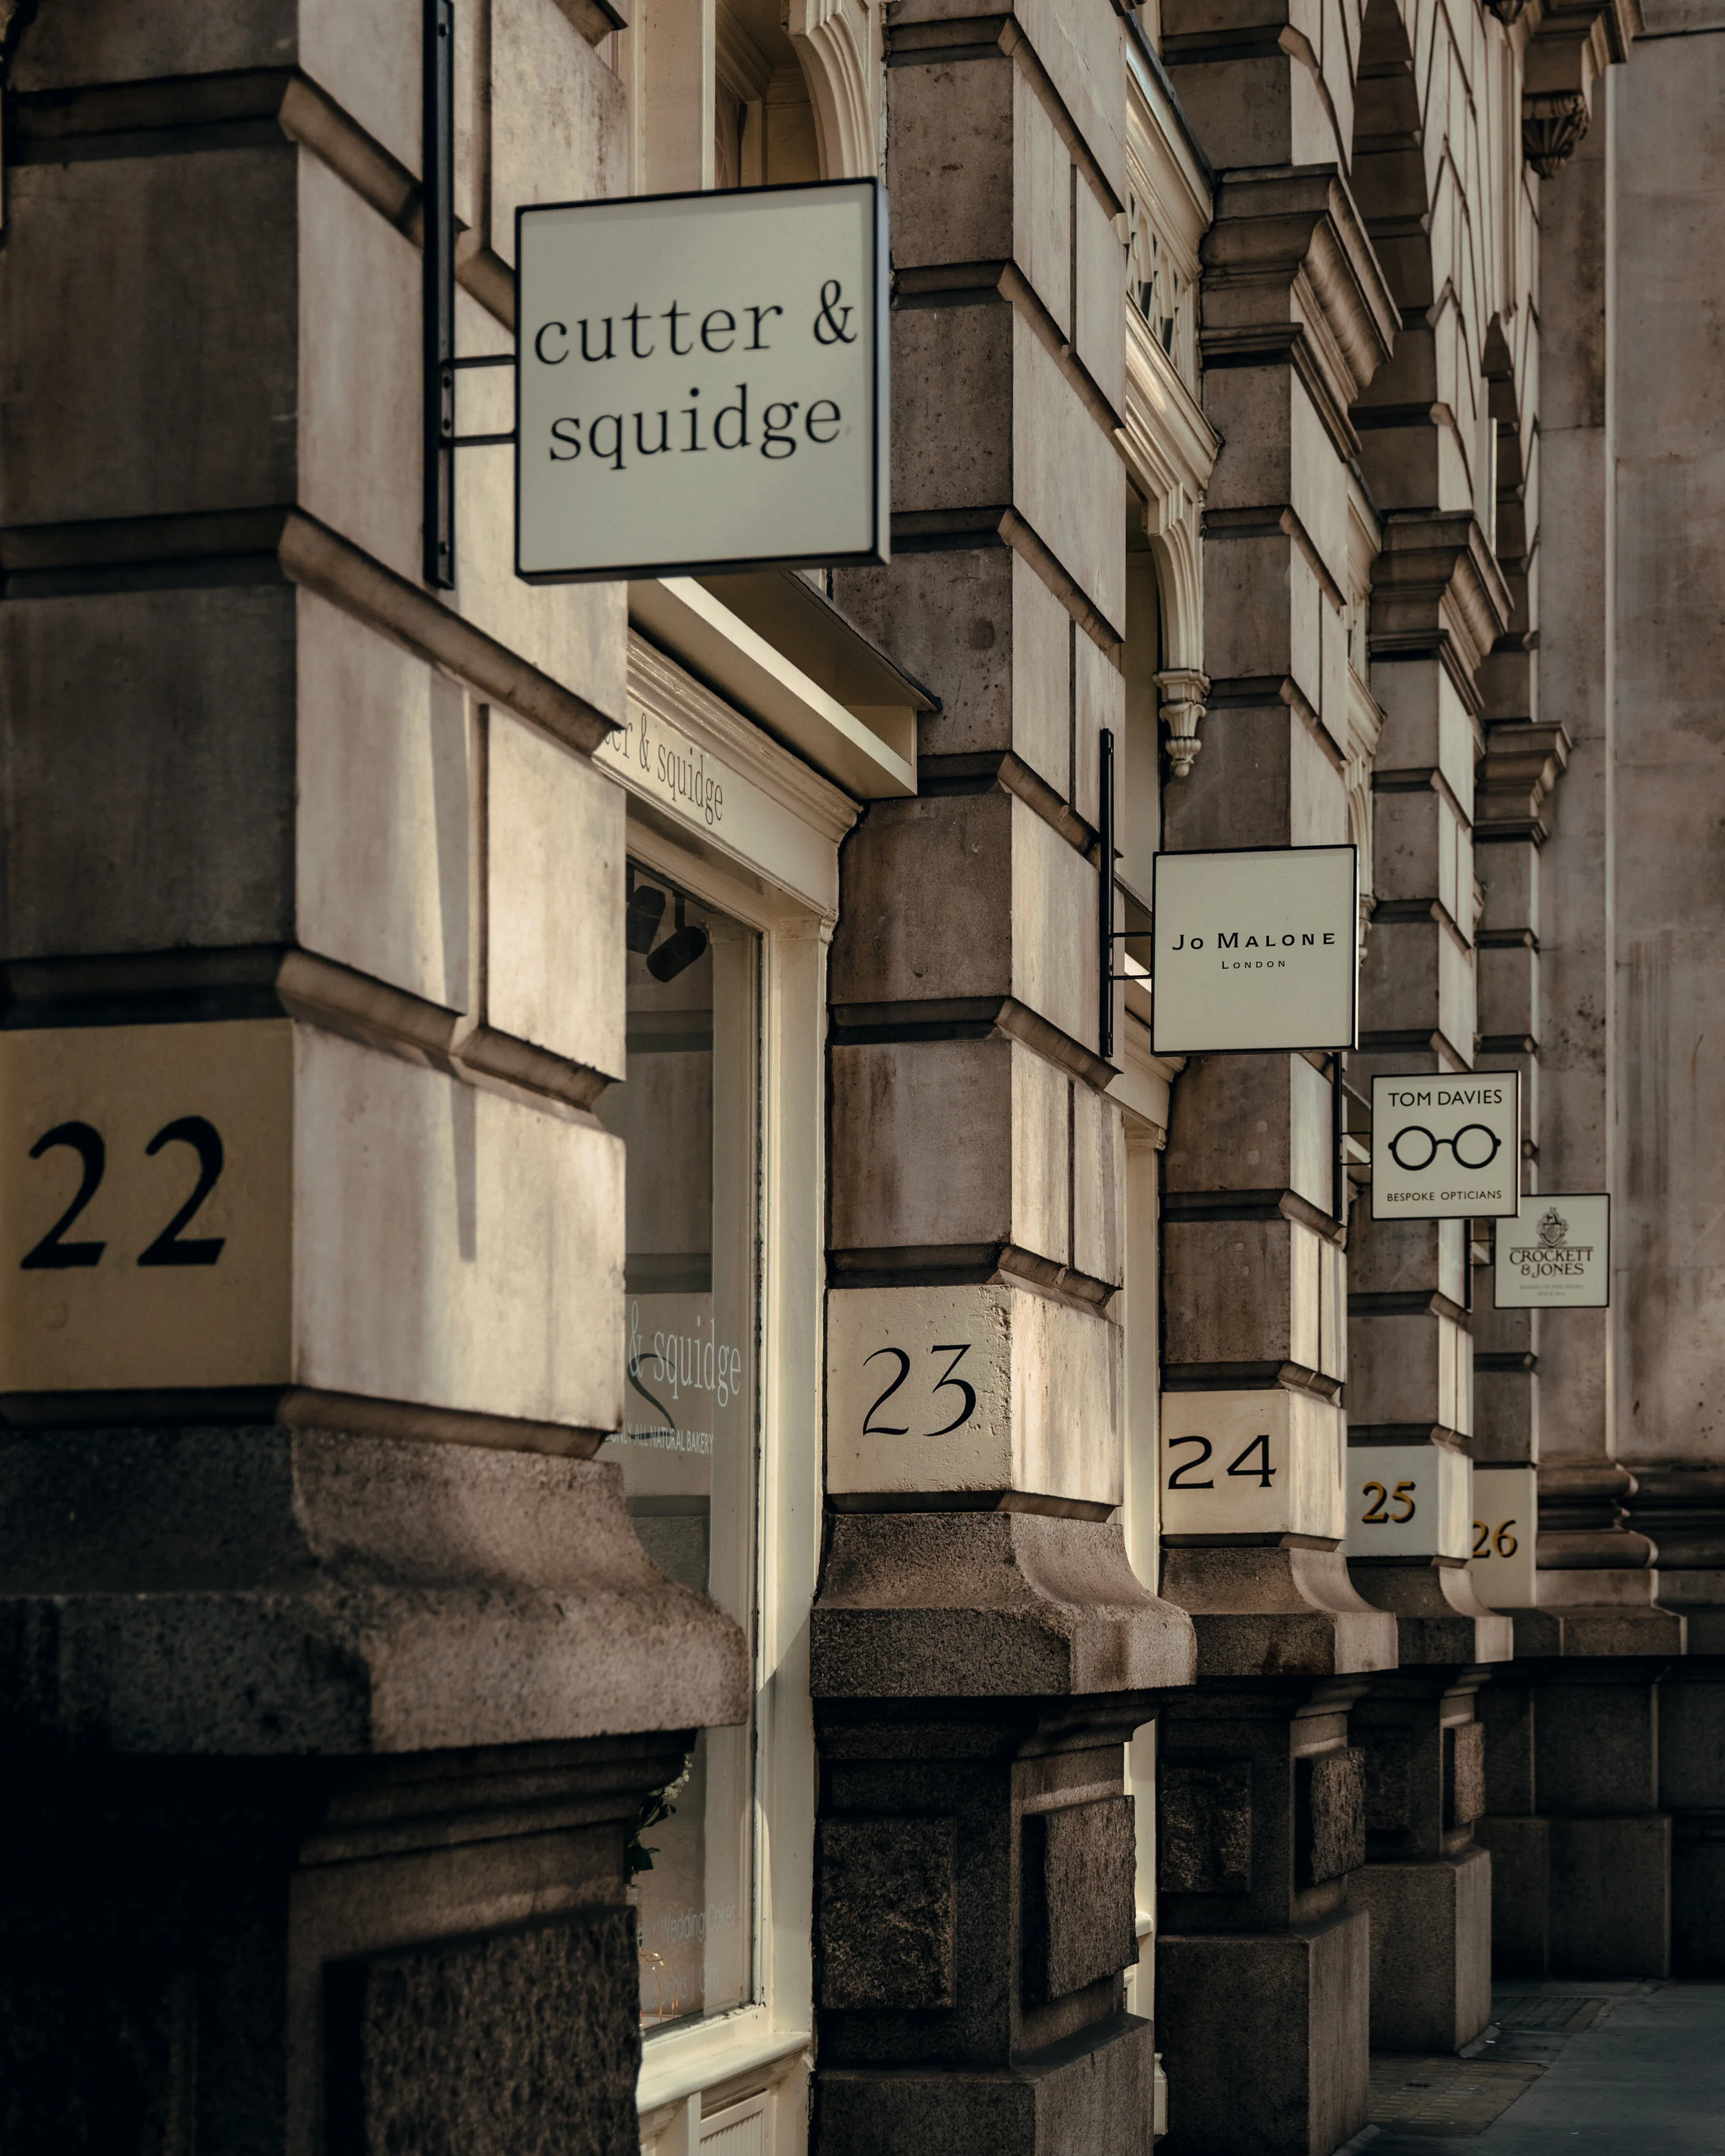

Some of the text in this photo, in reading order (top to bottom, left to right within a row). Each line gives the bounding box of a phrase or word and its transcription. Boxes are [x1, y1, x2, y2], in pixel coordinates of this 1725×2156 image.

[534, 279, 858, 365] cutter &
[549, 383, 842, 471] squidge
[639, 713, 651, 772] &
[658, 744, 723, 825] squidge
[1217, 932, 1336, 949] MALONE
[1221, 960, 1285, 969] LONDON
[1388, 1089, 1502, 1107] TOM DAVIES
[20, 1115, 227, 1269] 22
[1387, 1190, 1502, 1202] BESPOKE OPTICIANS
[1509, 1249, 1595, 1265] CROCKETT
[629, 1300, 742, 1407] & squidge
[862, 1344, 976, 1436] 23
[633, 1423, 649, 1446] ALL
[650, 1425, 685, 1452] NATURAL
[687, 1430, 714, 1455] BAKERY
[1167, 1434, 1278, 1490] 24
[1362, 1481, 1416, 1523] 25
[1473, 1519, 1518, 1559] 26
[660, 1907, 706, 1943] Wedding
